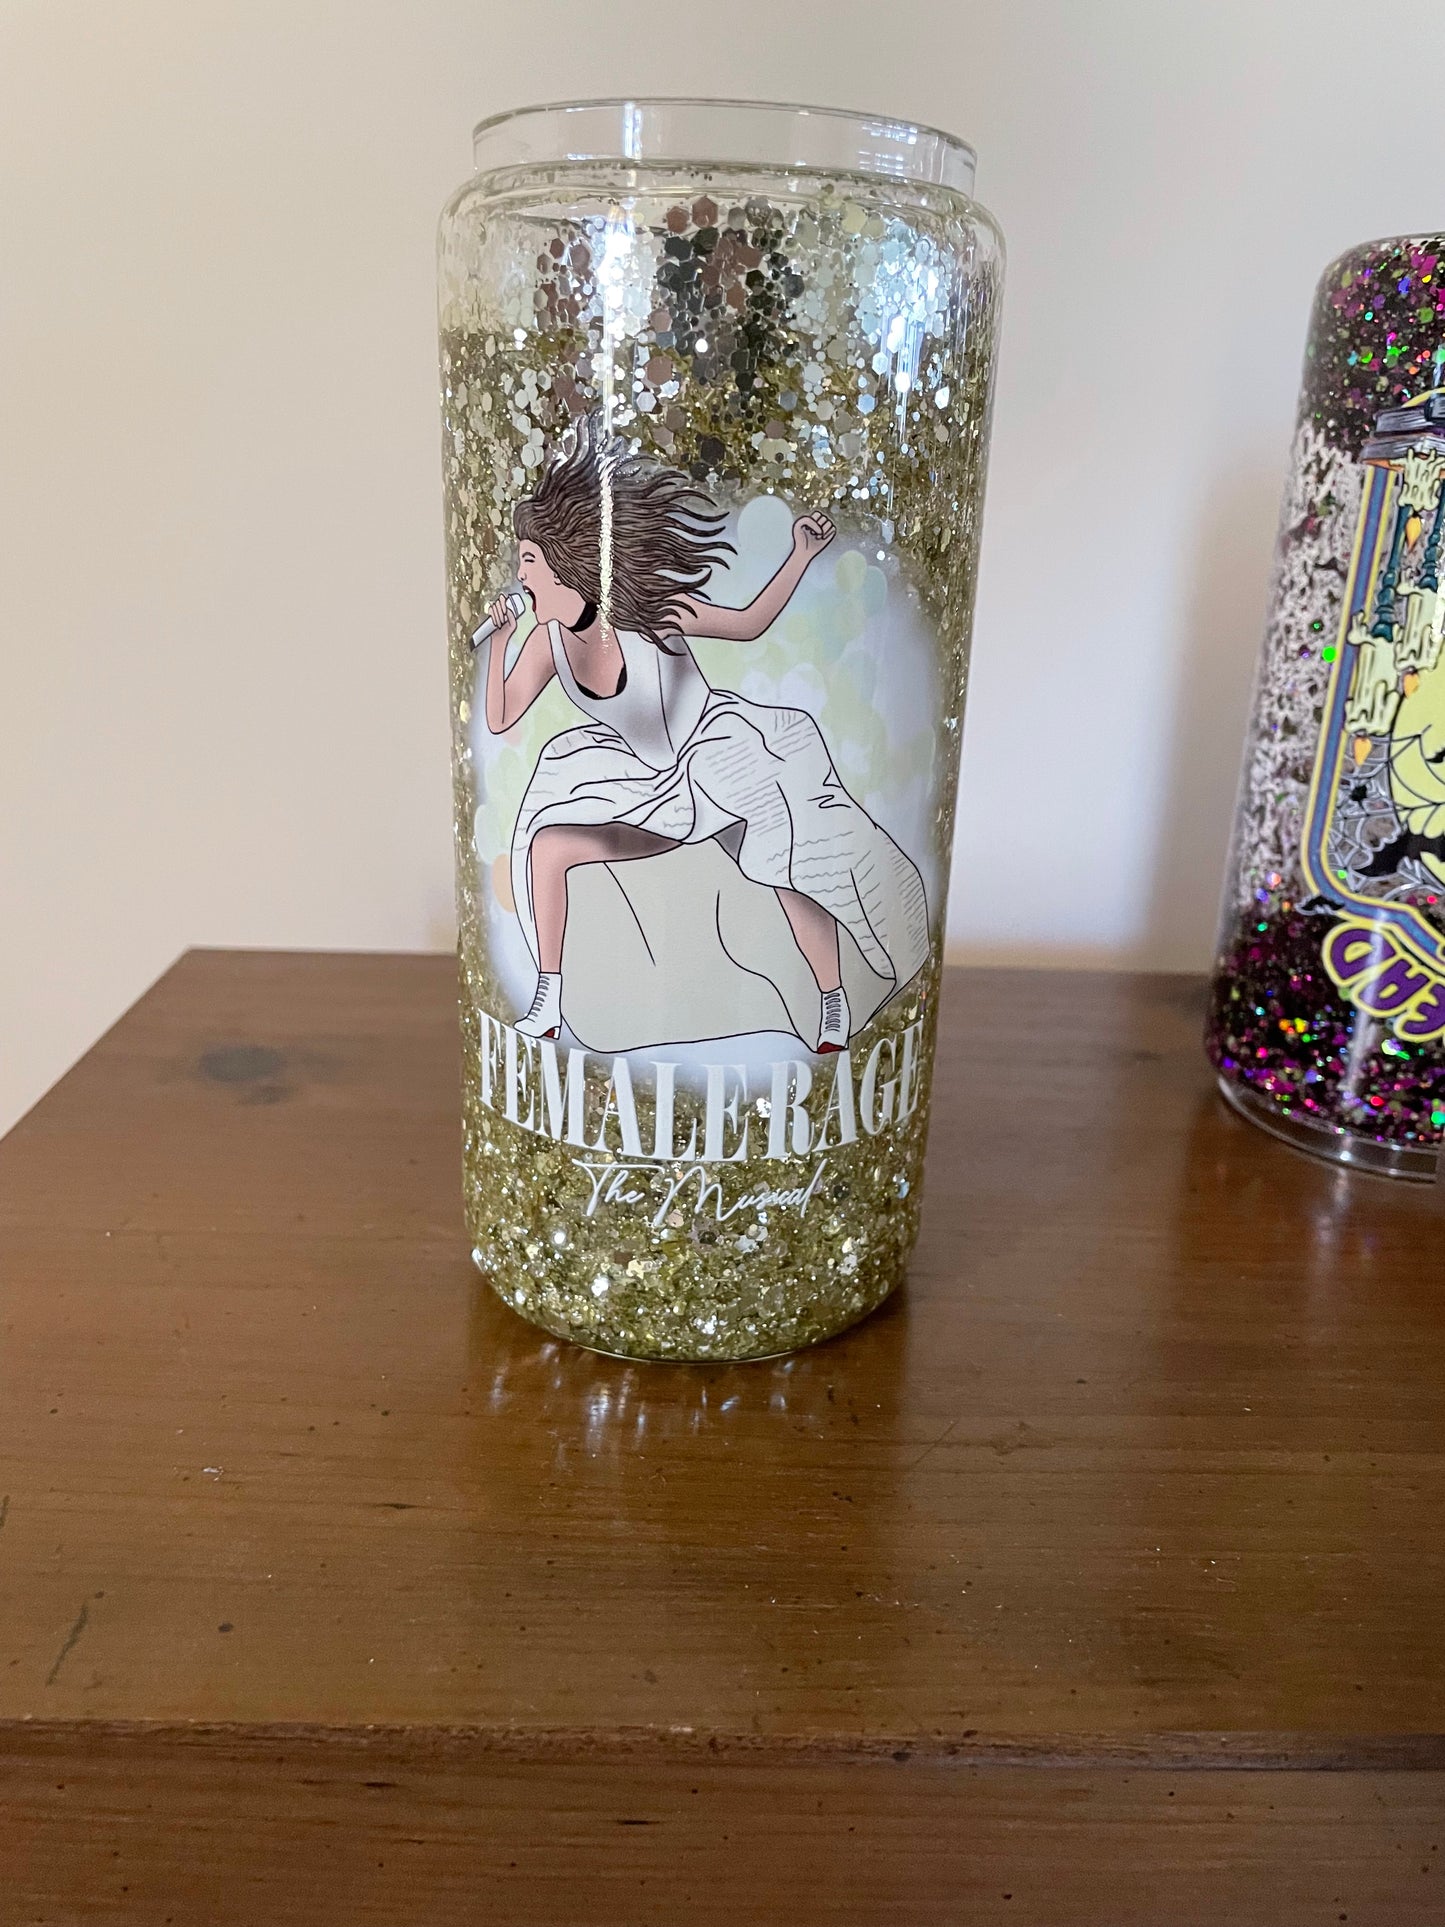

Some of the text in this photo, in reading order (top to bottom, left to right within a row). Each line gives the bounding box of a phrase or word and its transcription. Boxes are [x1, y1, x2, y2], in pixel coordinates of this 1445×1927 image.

[478, 1008, 923, 1162] FEMALE RAGE
[572, 1158, 827, 1227] The Musical
